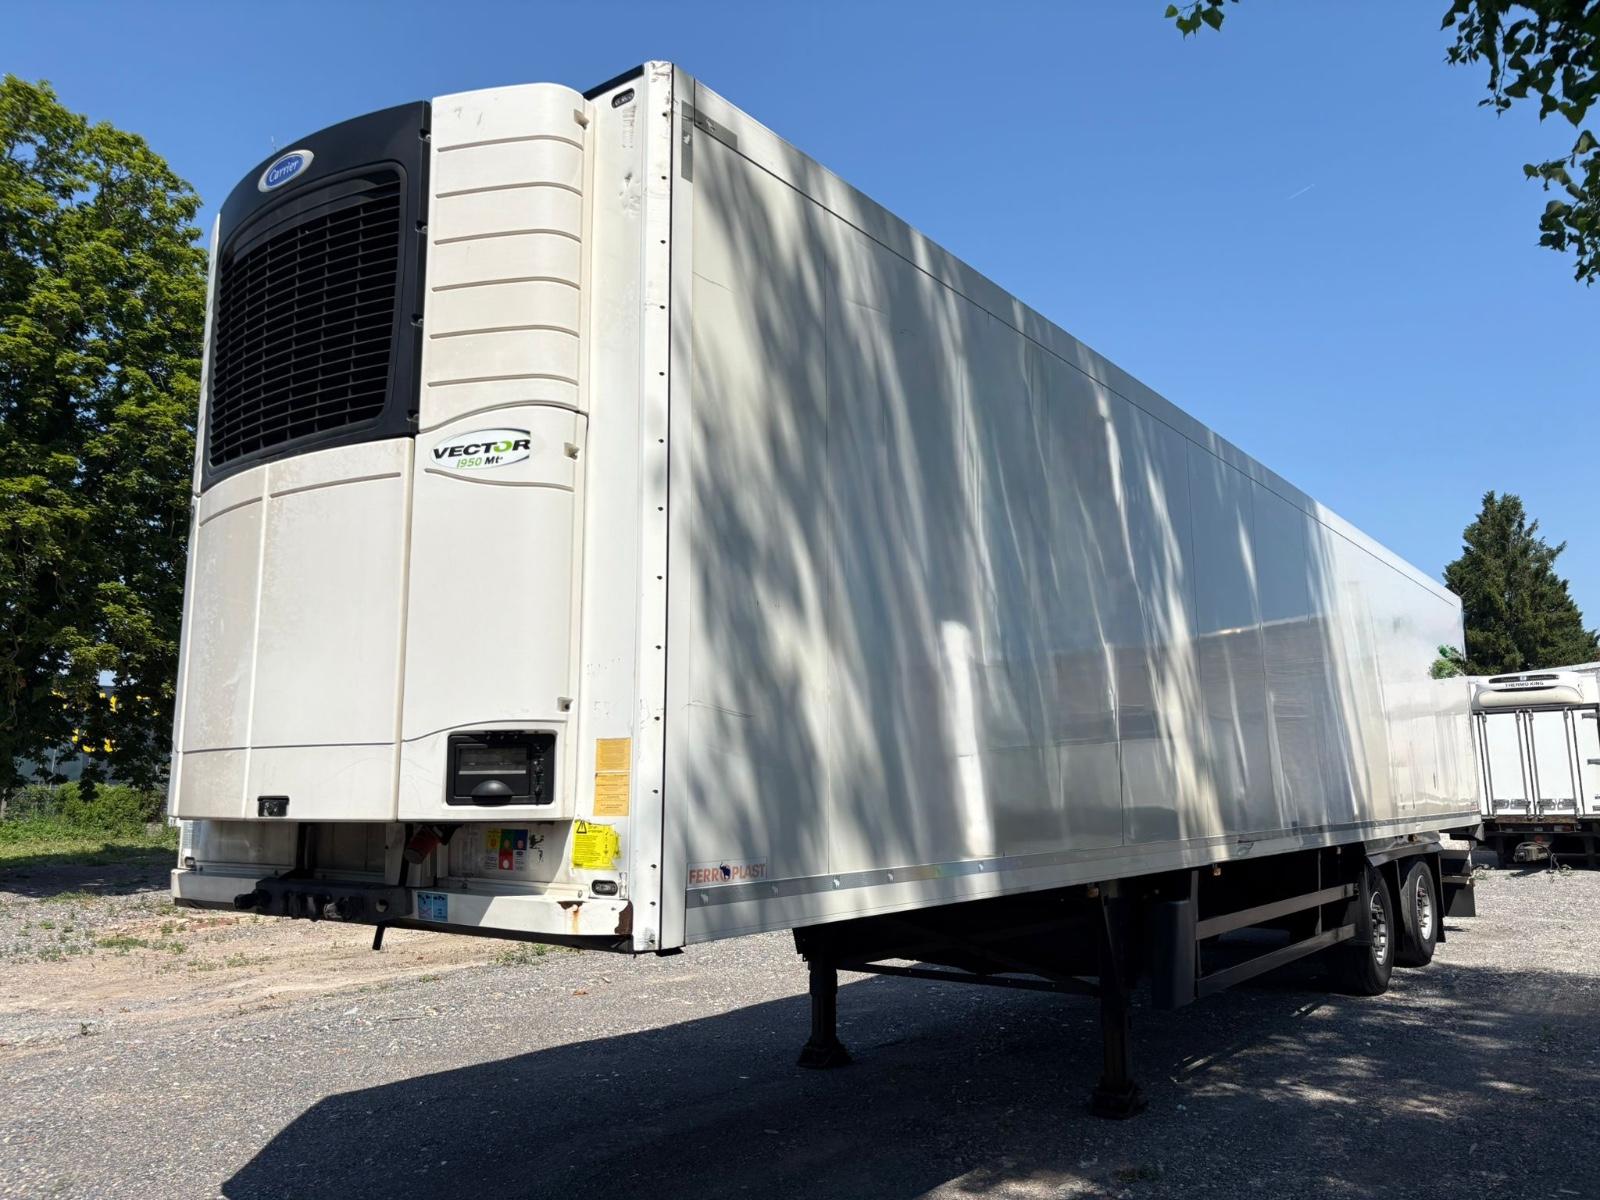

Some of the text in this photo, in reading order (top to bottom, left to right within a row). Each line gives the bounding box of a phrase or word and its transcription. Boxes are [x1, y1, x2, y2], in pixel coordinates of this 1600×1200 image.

[269, 159, 299, 182] Carrier
[433, 439, 530, 459] VECTOR
[456, 457, 482, 469] 1950
